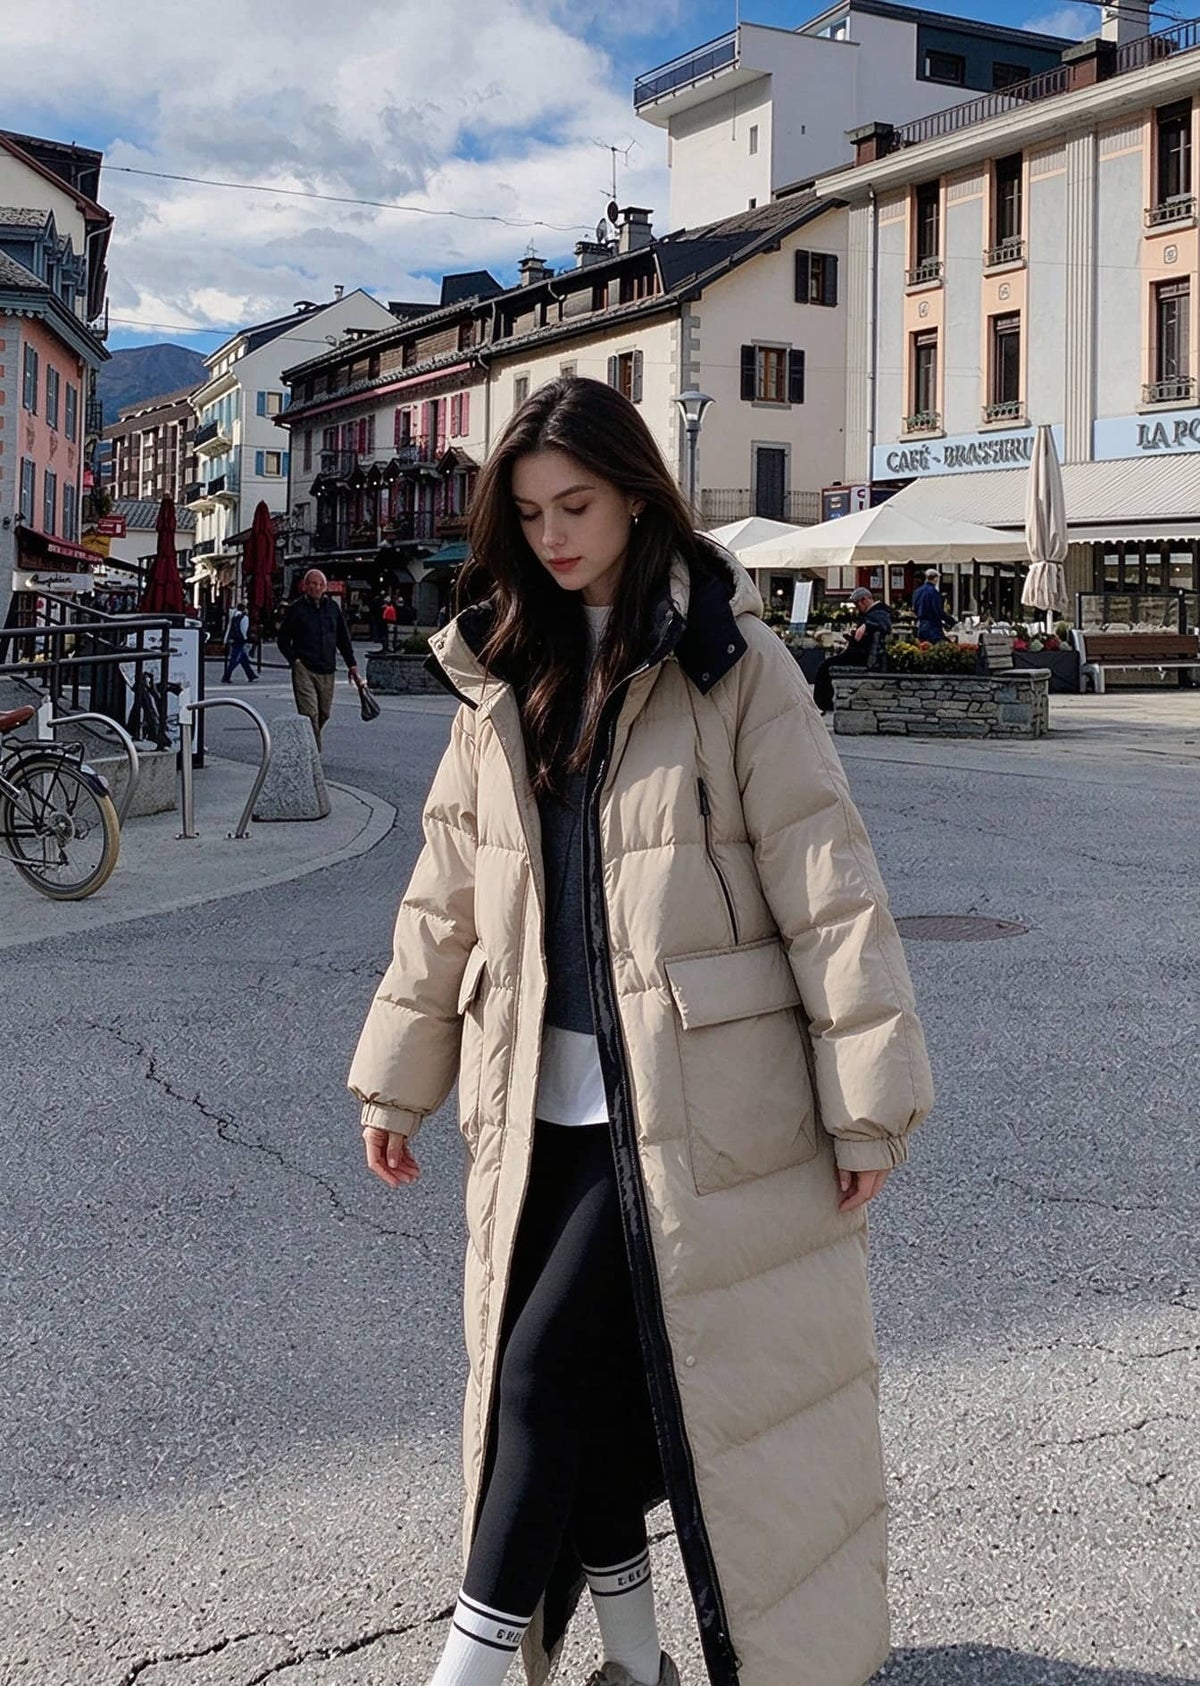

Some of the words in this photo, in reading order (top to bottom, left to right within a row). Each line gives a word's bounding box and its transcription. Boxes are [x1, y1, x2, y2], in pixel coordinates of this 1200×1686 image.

[1136, 422, 1171, 450] LA
[886, 444, 931, 474] CAFÉ
[944, 437, 1034, 468] BRASSERI
